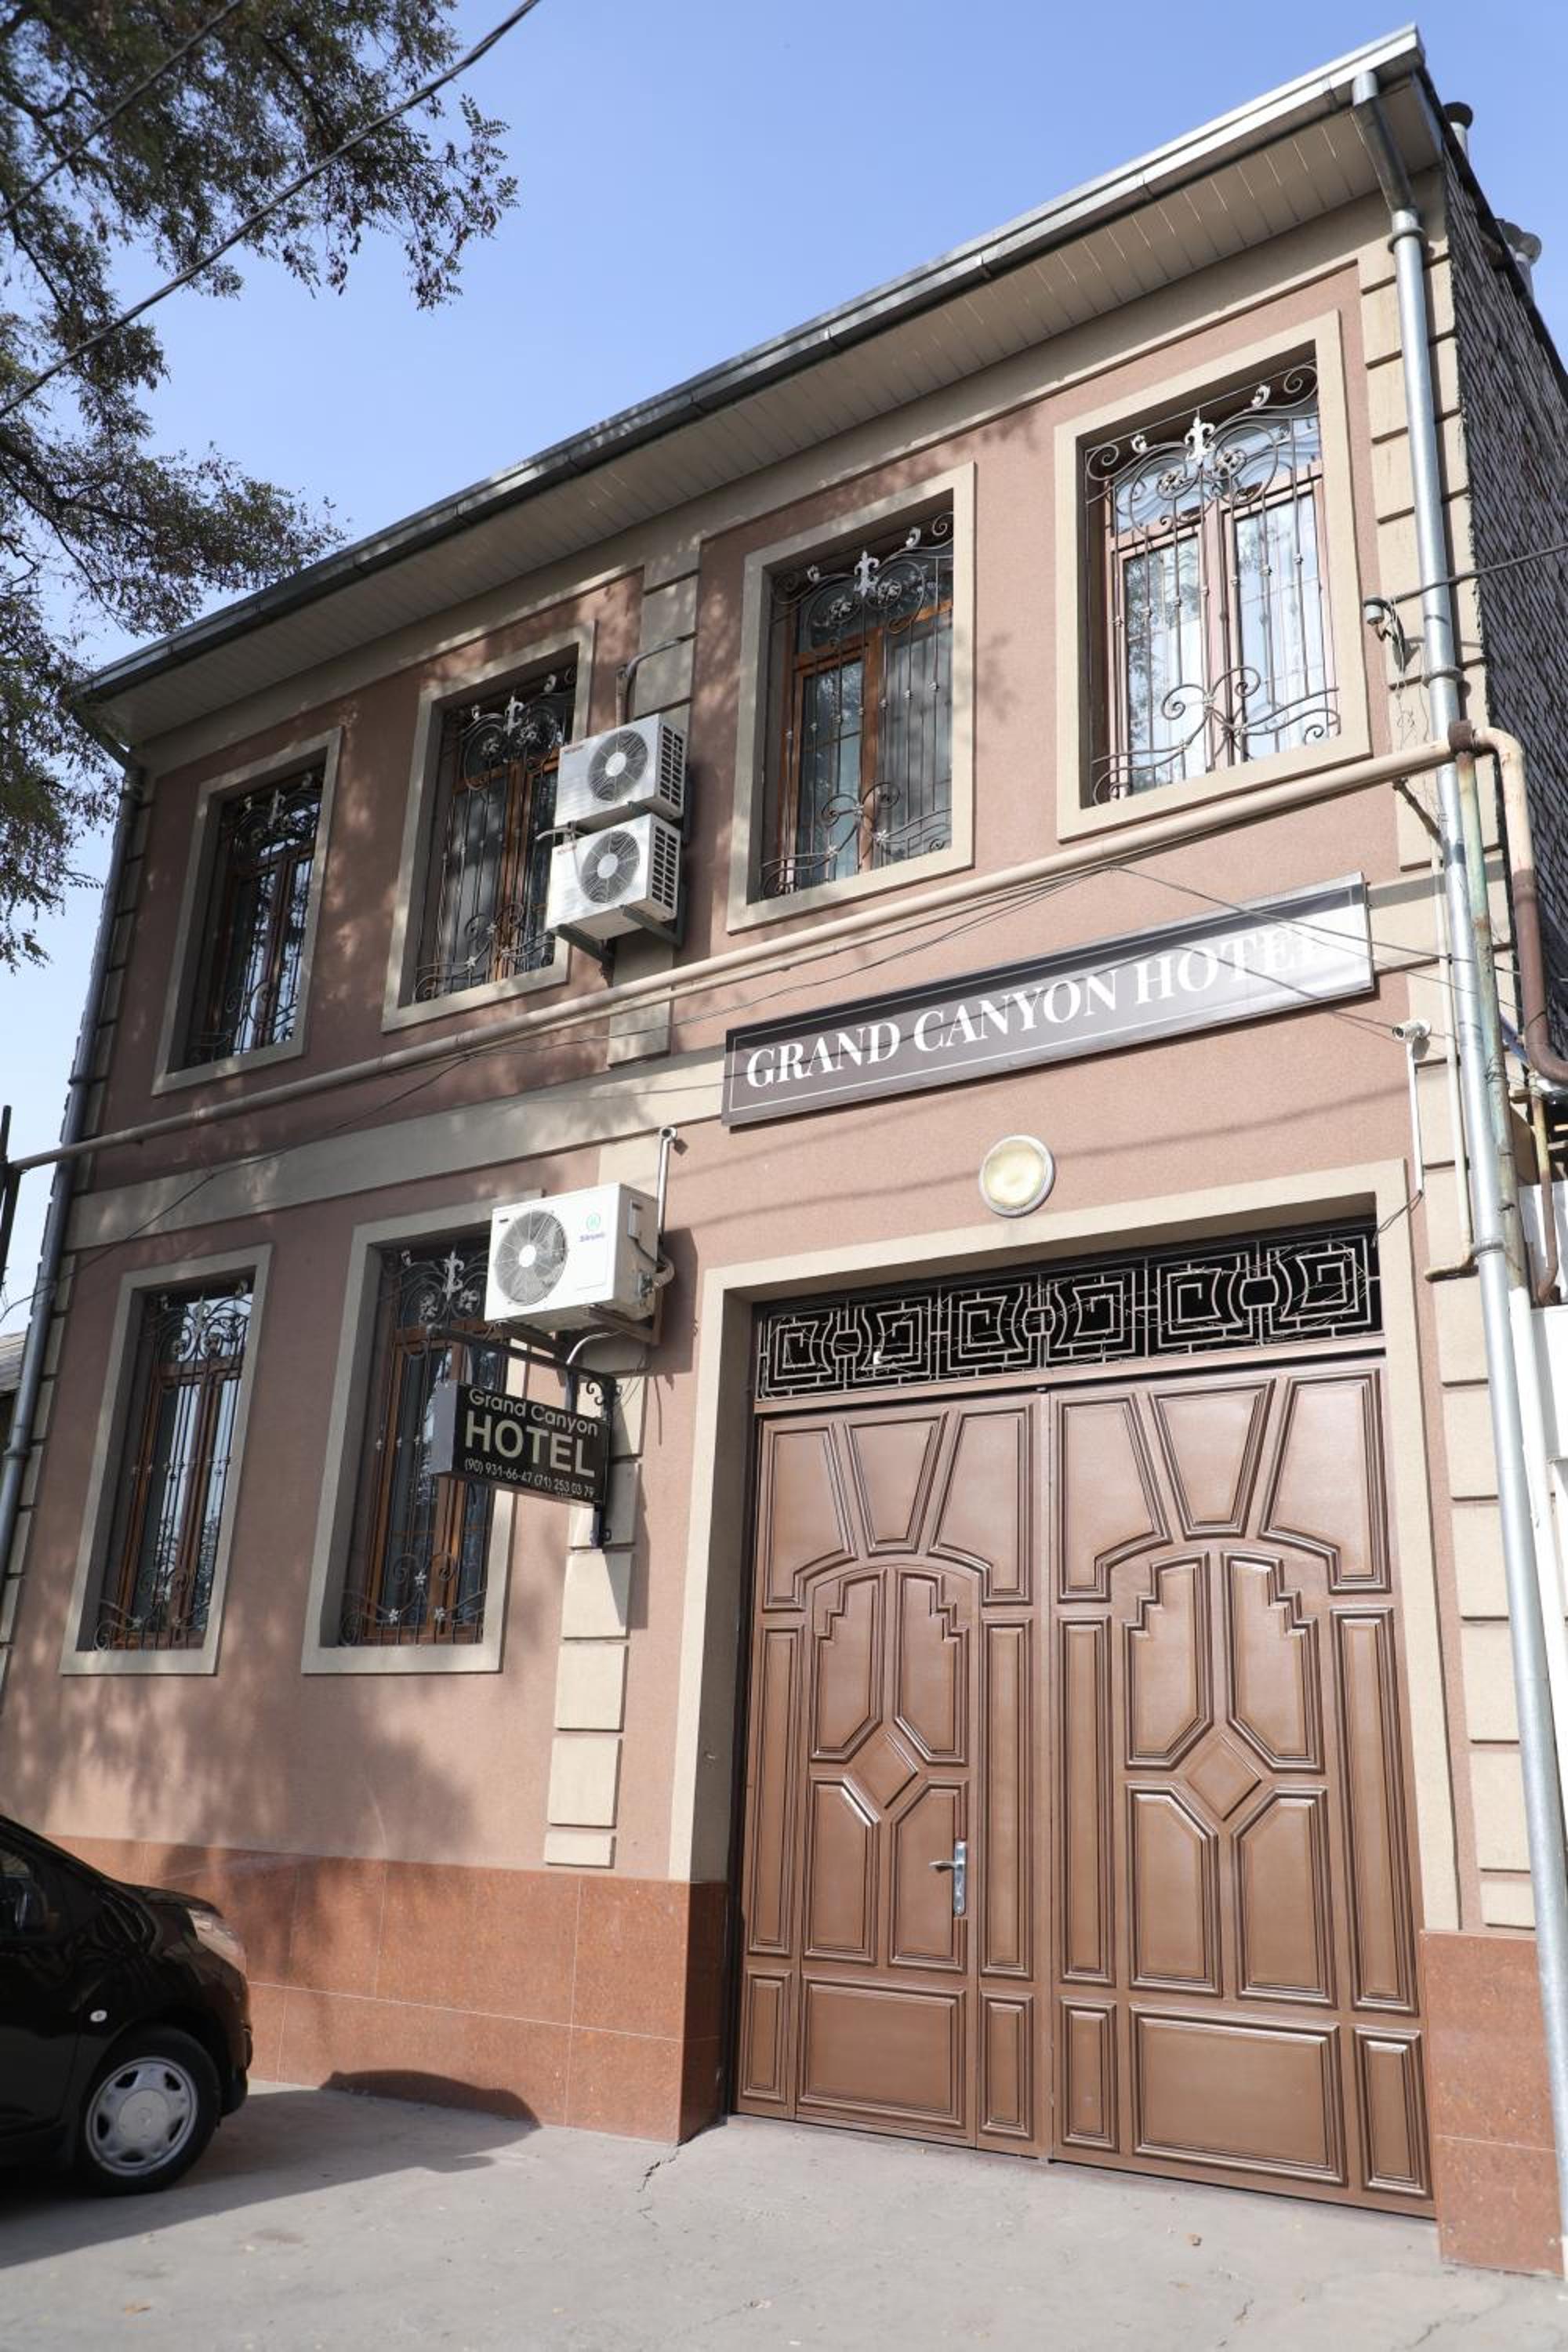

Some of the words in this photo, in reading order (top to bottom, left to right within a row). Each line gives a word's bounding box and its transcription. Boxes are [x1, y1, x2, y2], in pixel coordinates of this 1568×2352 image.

[746, 1022, 900, 1088] GRAND
[914, 970, 1118, 1052] CANYON
[465, 1410, 595, 1478] HOTEL
[470, 1388, 526, 1417] Grand
[531, 1404, 598, 1436] Canyon
